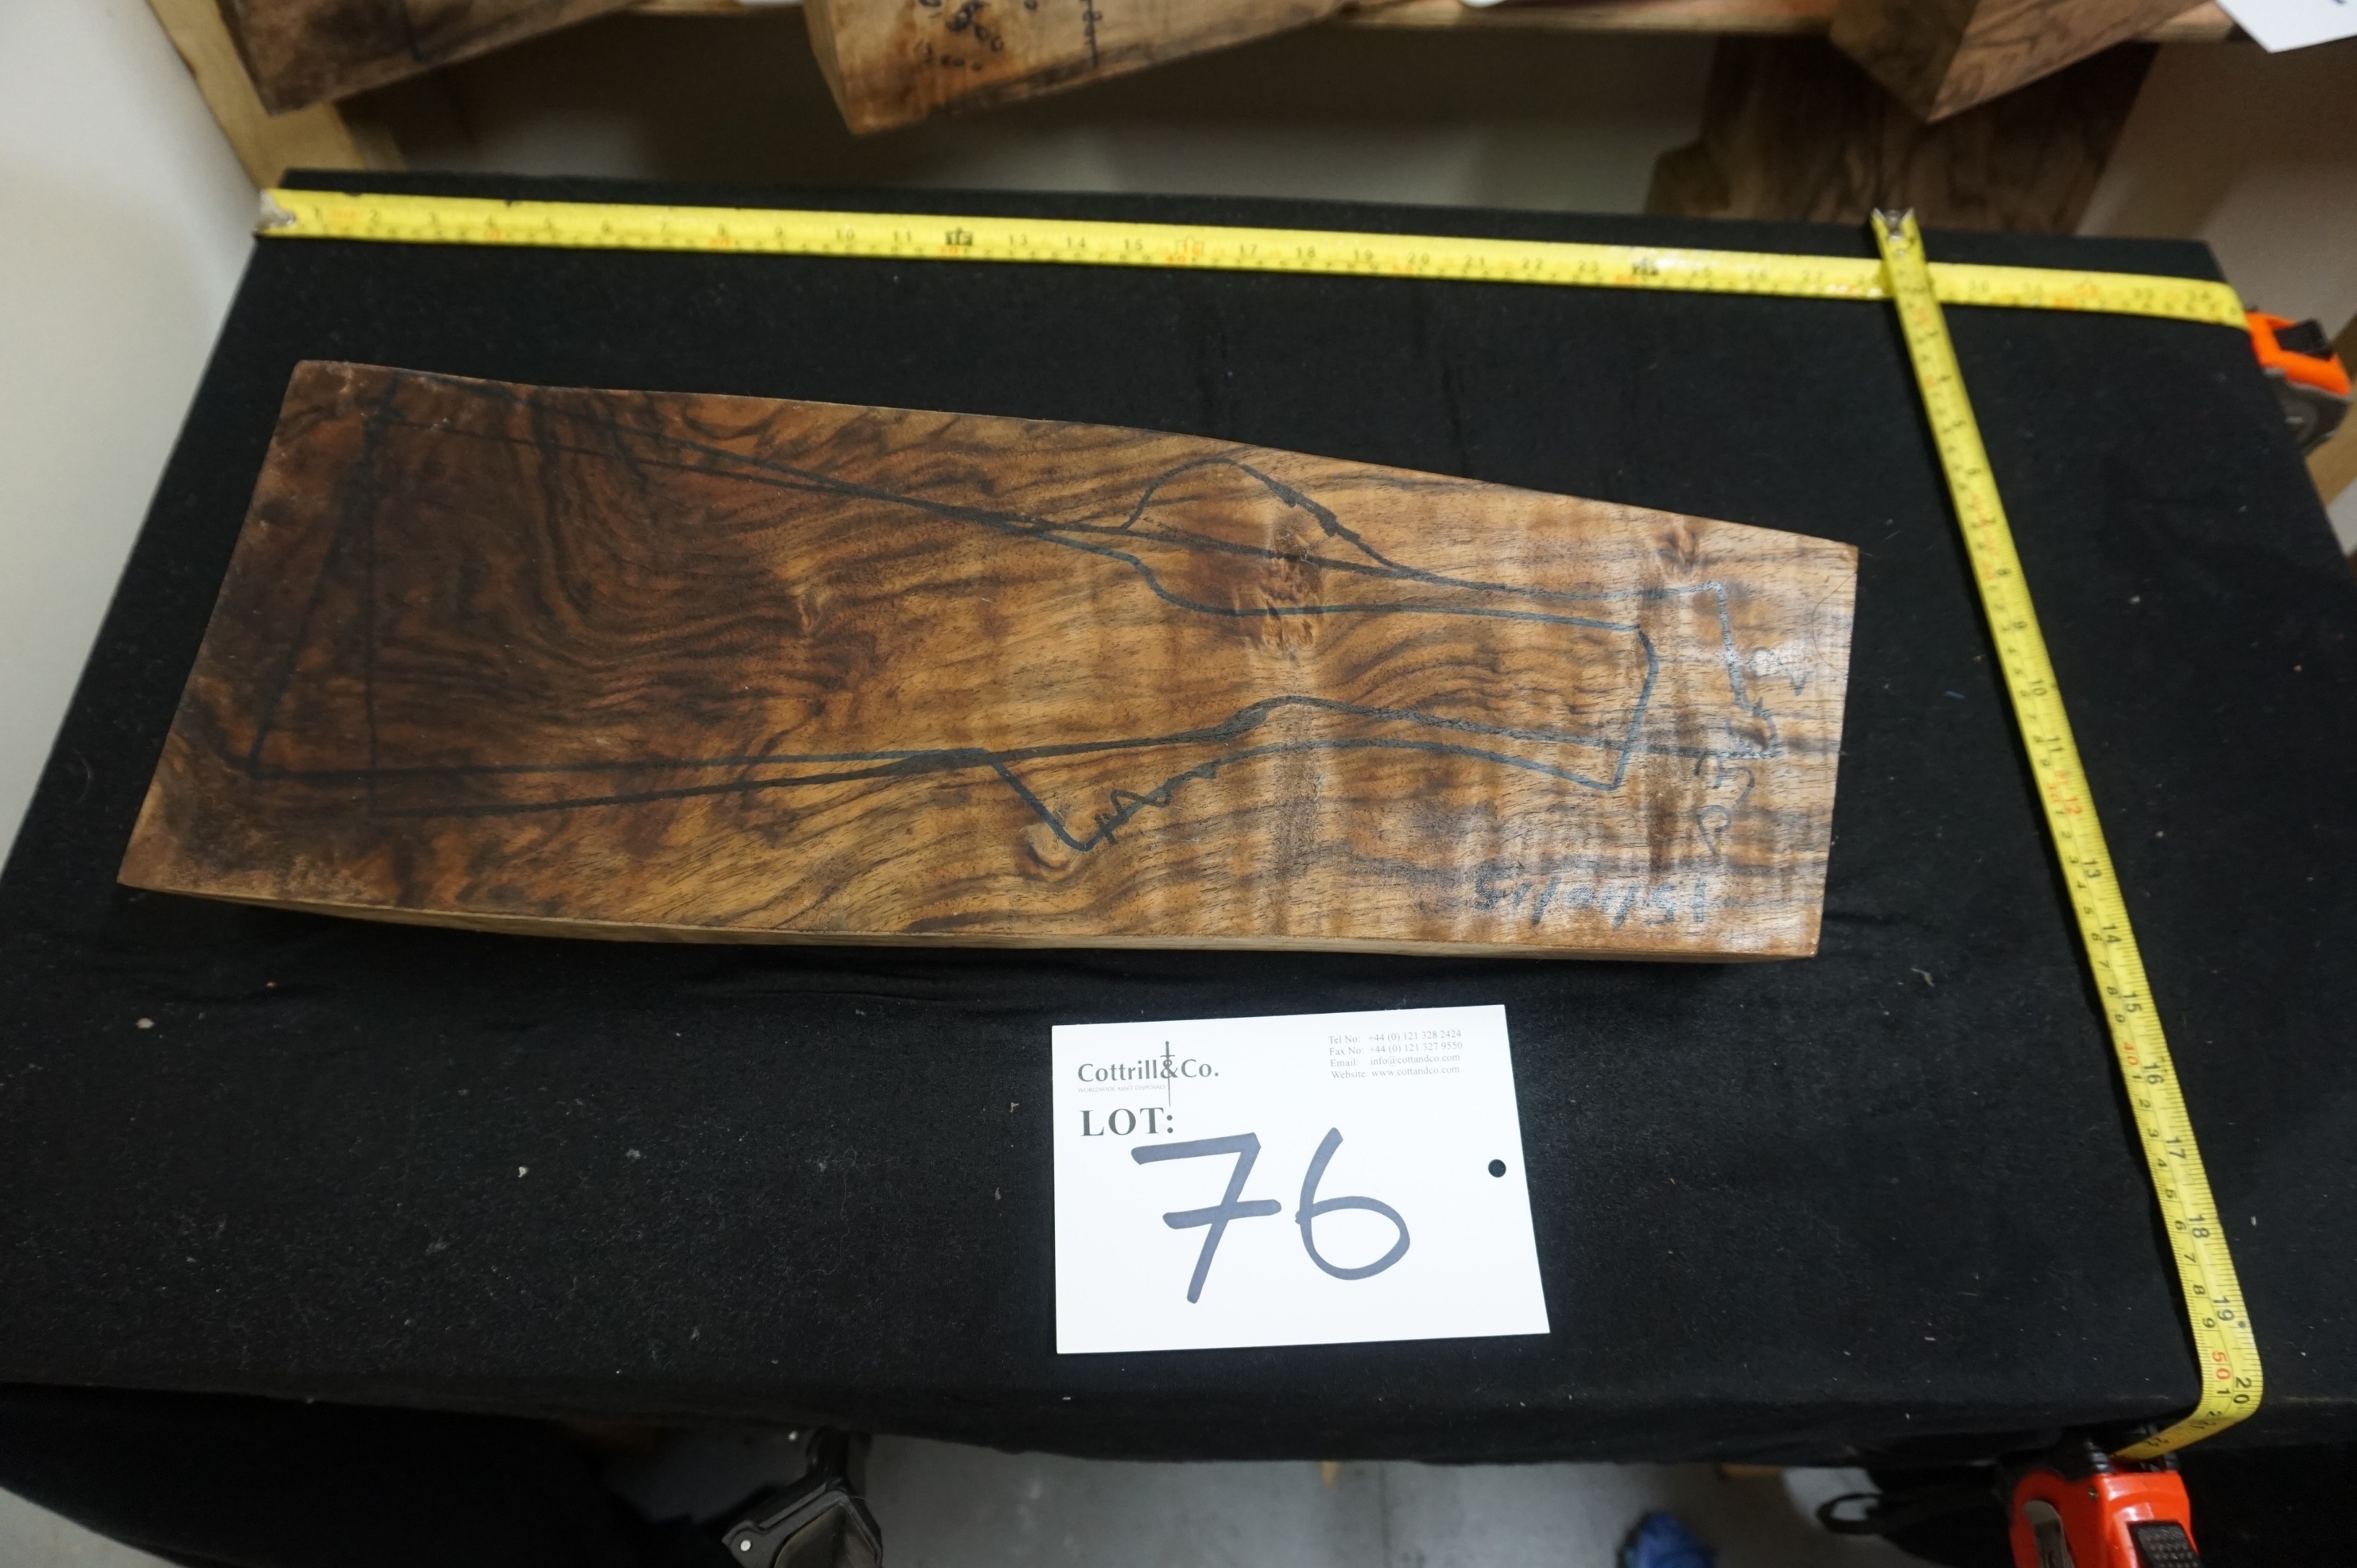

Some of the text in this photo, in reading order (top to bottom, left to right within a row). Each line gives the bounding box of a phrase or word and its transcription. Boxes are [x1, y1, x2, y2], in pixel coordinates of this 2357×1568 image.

[1239, 243, 1258, 256] 17
[1408, 252, 1430, 265] 20
[1329, 1029, 1462, 1044] Tel No: +44 (0) 121 328 2424
[1329, 1041, 1463, 1056] Fax No: +44 (0) 121 327 9550
[1330, 1053, 1461, 1068] Email: info@cottandco.com
[1331, 1066, 1461, 1079] Website: www.cottandco.com
[1079, 1107, 1174, 1137] LOT:
[2083, 857, 2102, 879] 13
[2103, 923, 2122, 944] 14
[2122, 992, 2143, 1013] 15
[2144, 1063, 2165, 1085] 16
[2166, 1136, 2187, 1159] 17
[2188, 1213, 2210, 1239] 18
[2213, 1295, 2235, 1321] 19
[2232, 1377, 2252, 1405] 20
[1130, 1126, 1411, 1305] 76
[2123, 1041, 2140, 1067] 40
[2202, 1317, 2216, 1329] 9
[2211, 1351, 2232, 1381] 50
